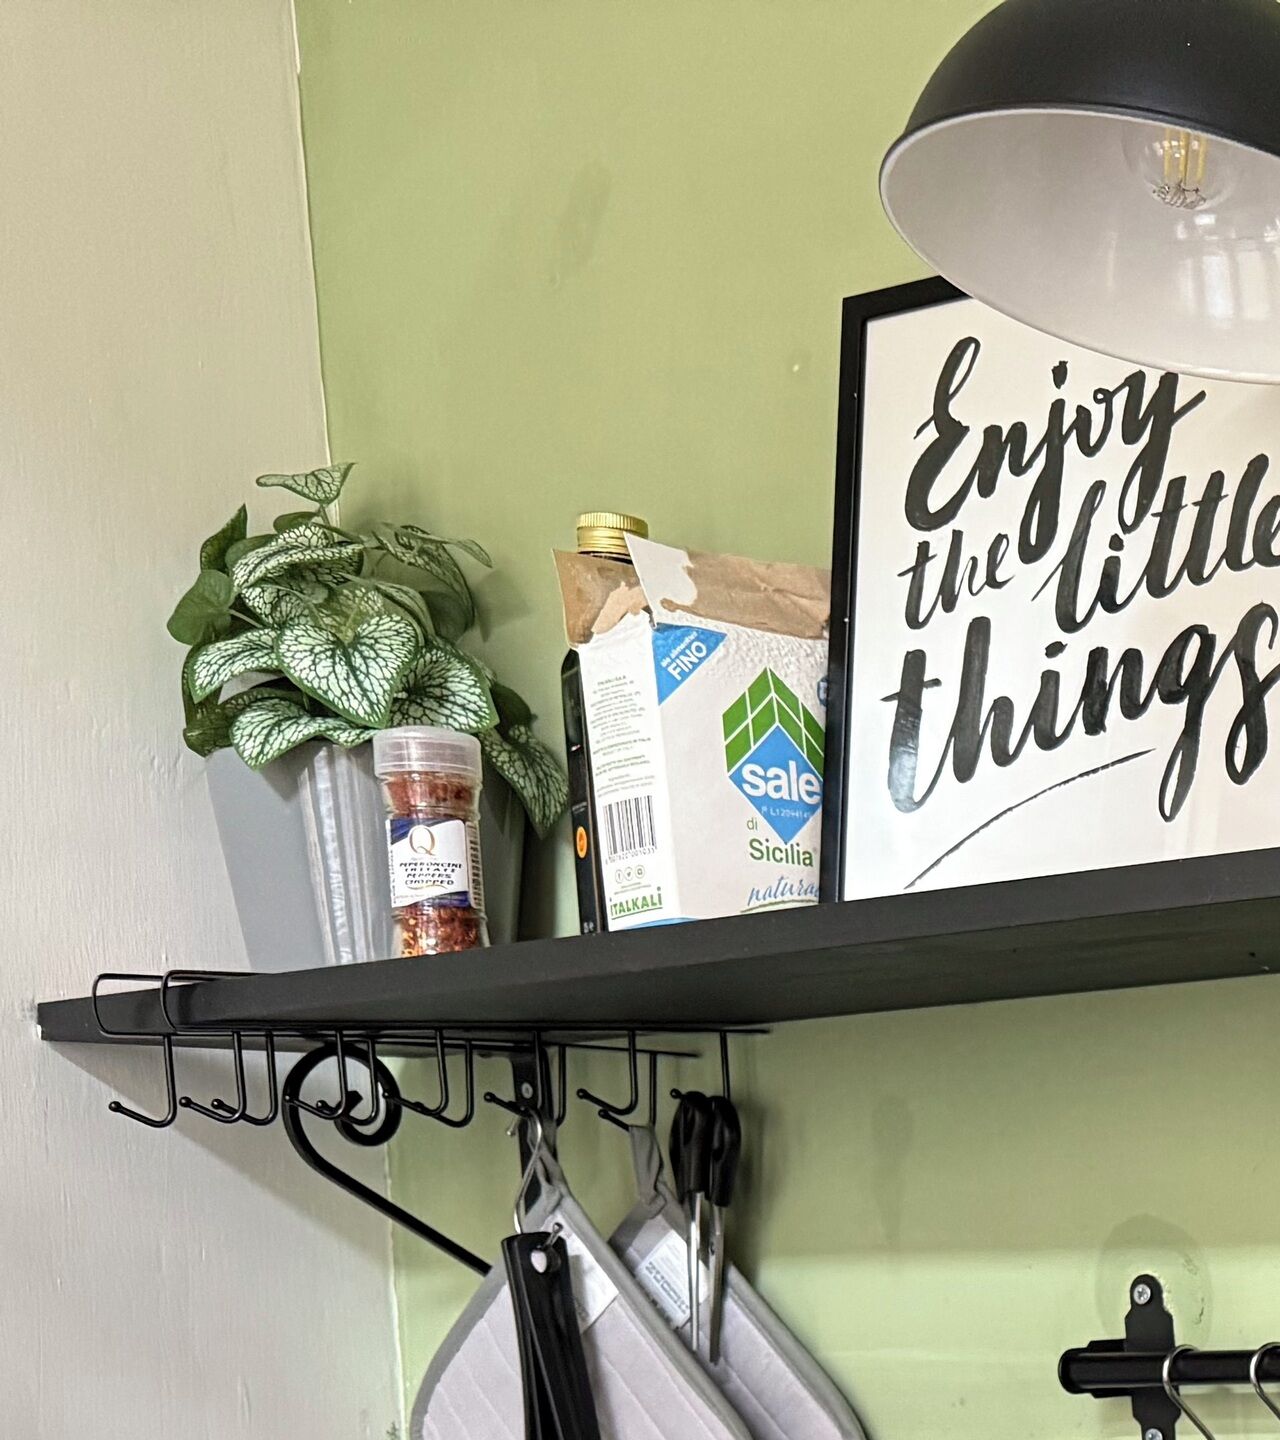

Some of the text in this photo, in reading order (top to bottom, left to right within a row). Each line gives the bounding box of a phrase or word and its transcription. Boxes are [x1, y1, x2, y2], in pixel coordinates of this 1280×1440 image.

[905, 336, 1206, 564] Enjoy
[897, 534, 1014, 629] the
[667, 641, 707, 680] FINO
[741, 760, 822, 805] sale
[747, 817, 758, 831] di
[749, 838, 814, 868] Sicilia
